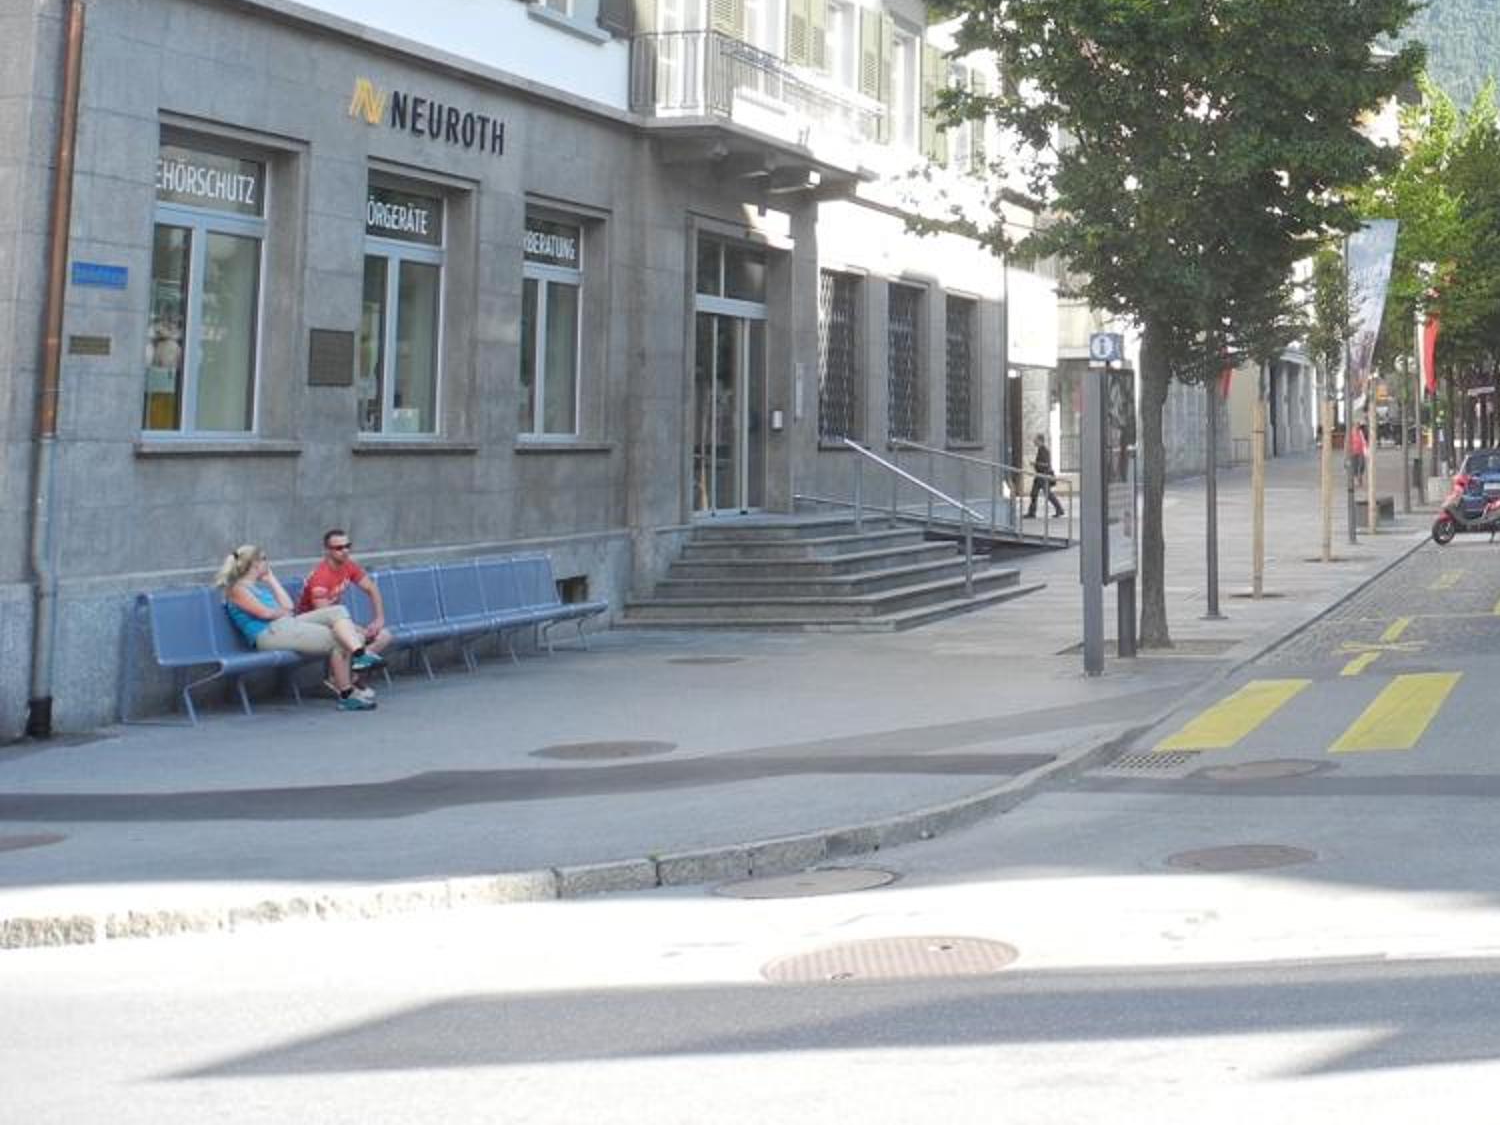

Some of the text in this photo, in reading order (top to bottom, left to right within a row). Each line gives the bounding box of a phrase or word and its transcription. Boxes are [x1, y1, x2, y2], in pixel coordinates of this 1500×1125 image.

[391, 90, 505, 155] NEUROTH
[156, 156, 255, 204] EHÖRSCHUTZ
[367, 195, 428, 235] ÖRGERÄTE
[523, 230, 576, 261] BERATUNG
